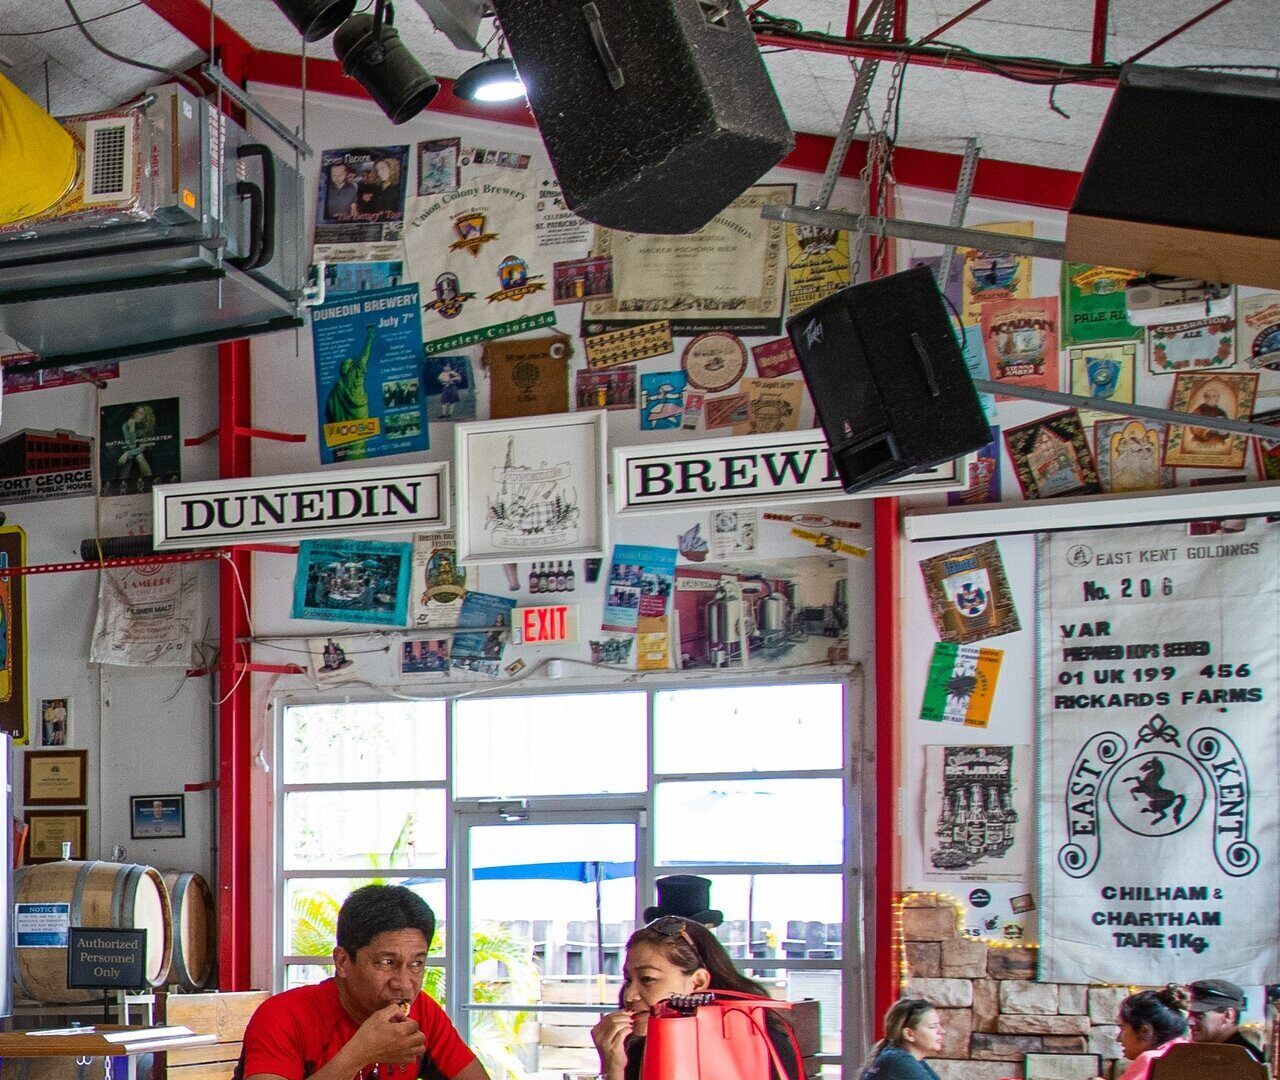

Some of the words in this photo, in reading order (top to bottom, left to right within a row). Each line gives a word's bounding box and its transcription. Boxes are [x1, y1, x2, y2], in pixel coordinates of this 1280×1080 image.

[412, 201, 441, 228] Union
[441, 186, 479, 203] Colony
[482, 183, 528, 202] Brewery
[313, 303, 361, 321] DUNEDIN
[364, 293, 418, 313] BREWERY
[378, 317, 399, 329] July
[1074, 312, 1106, 323] PALE
[1110, 310, 1127, 320] AL
[1157, 316, 1228, 333] CELEBRATION
[487, 314, 555, 338] Colorado
[1183, 330, 1202, 339] ALE
[594, 343, 627, 354] TRAVEL
[644, 335, 662, 343] RAIL
[35, 470, 92, 486] GEORGE
[634, 448, 938, 498] BREW
[37, 485, 63, 494] PUBLIC
[67, 482, 92, 490] HOUSE
[181, 482, 421, 531] DUNEDIN
[1096, 552, 1132, 566] EAST
[1140, 548, 1177, 563] KENT
[1187, 542, 1259, 560] GOLDINGS
[1083, 580, 1109, 601] No.
[126, 606, 153, 615] PILSNER
[155, 604, 172, 612] MALT
[524, 607, 567, 642] EXIT
[1060, 621, 1111, 638] VAR
[1126, 643, 1160, 659] HOPS
[1094, 669, 1125, 684] UK
[1133, 666, 1176, 682] 199
[1199, 664, 1251, 678] 456
[1054, 691, 1170, 709] RICKARDS
[1181, 688, 1263, 705] FARMS
[945, 766, 1009, 775] BEWARE
[1071, 758, 1102, 836] EAST
[1212, 758, 1244, 839] KENT
[1101, 886, 1208, 901] CHILHAM
[1213, 888, 1223, 899] &
[1092, 911, 1222, 926] CHARTHAM
[77, 938, 138, 949] Authorized
[1113, 932, 1165, 948] TARE
[80, 953, 134, 963] Personnel
[94, 967, 120, 978] Only
